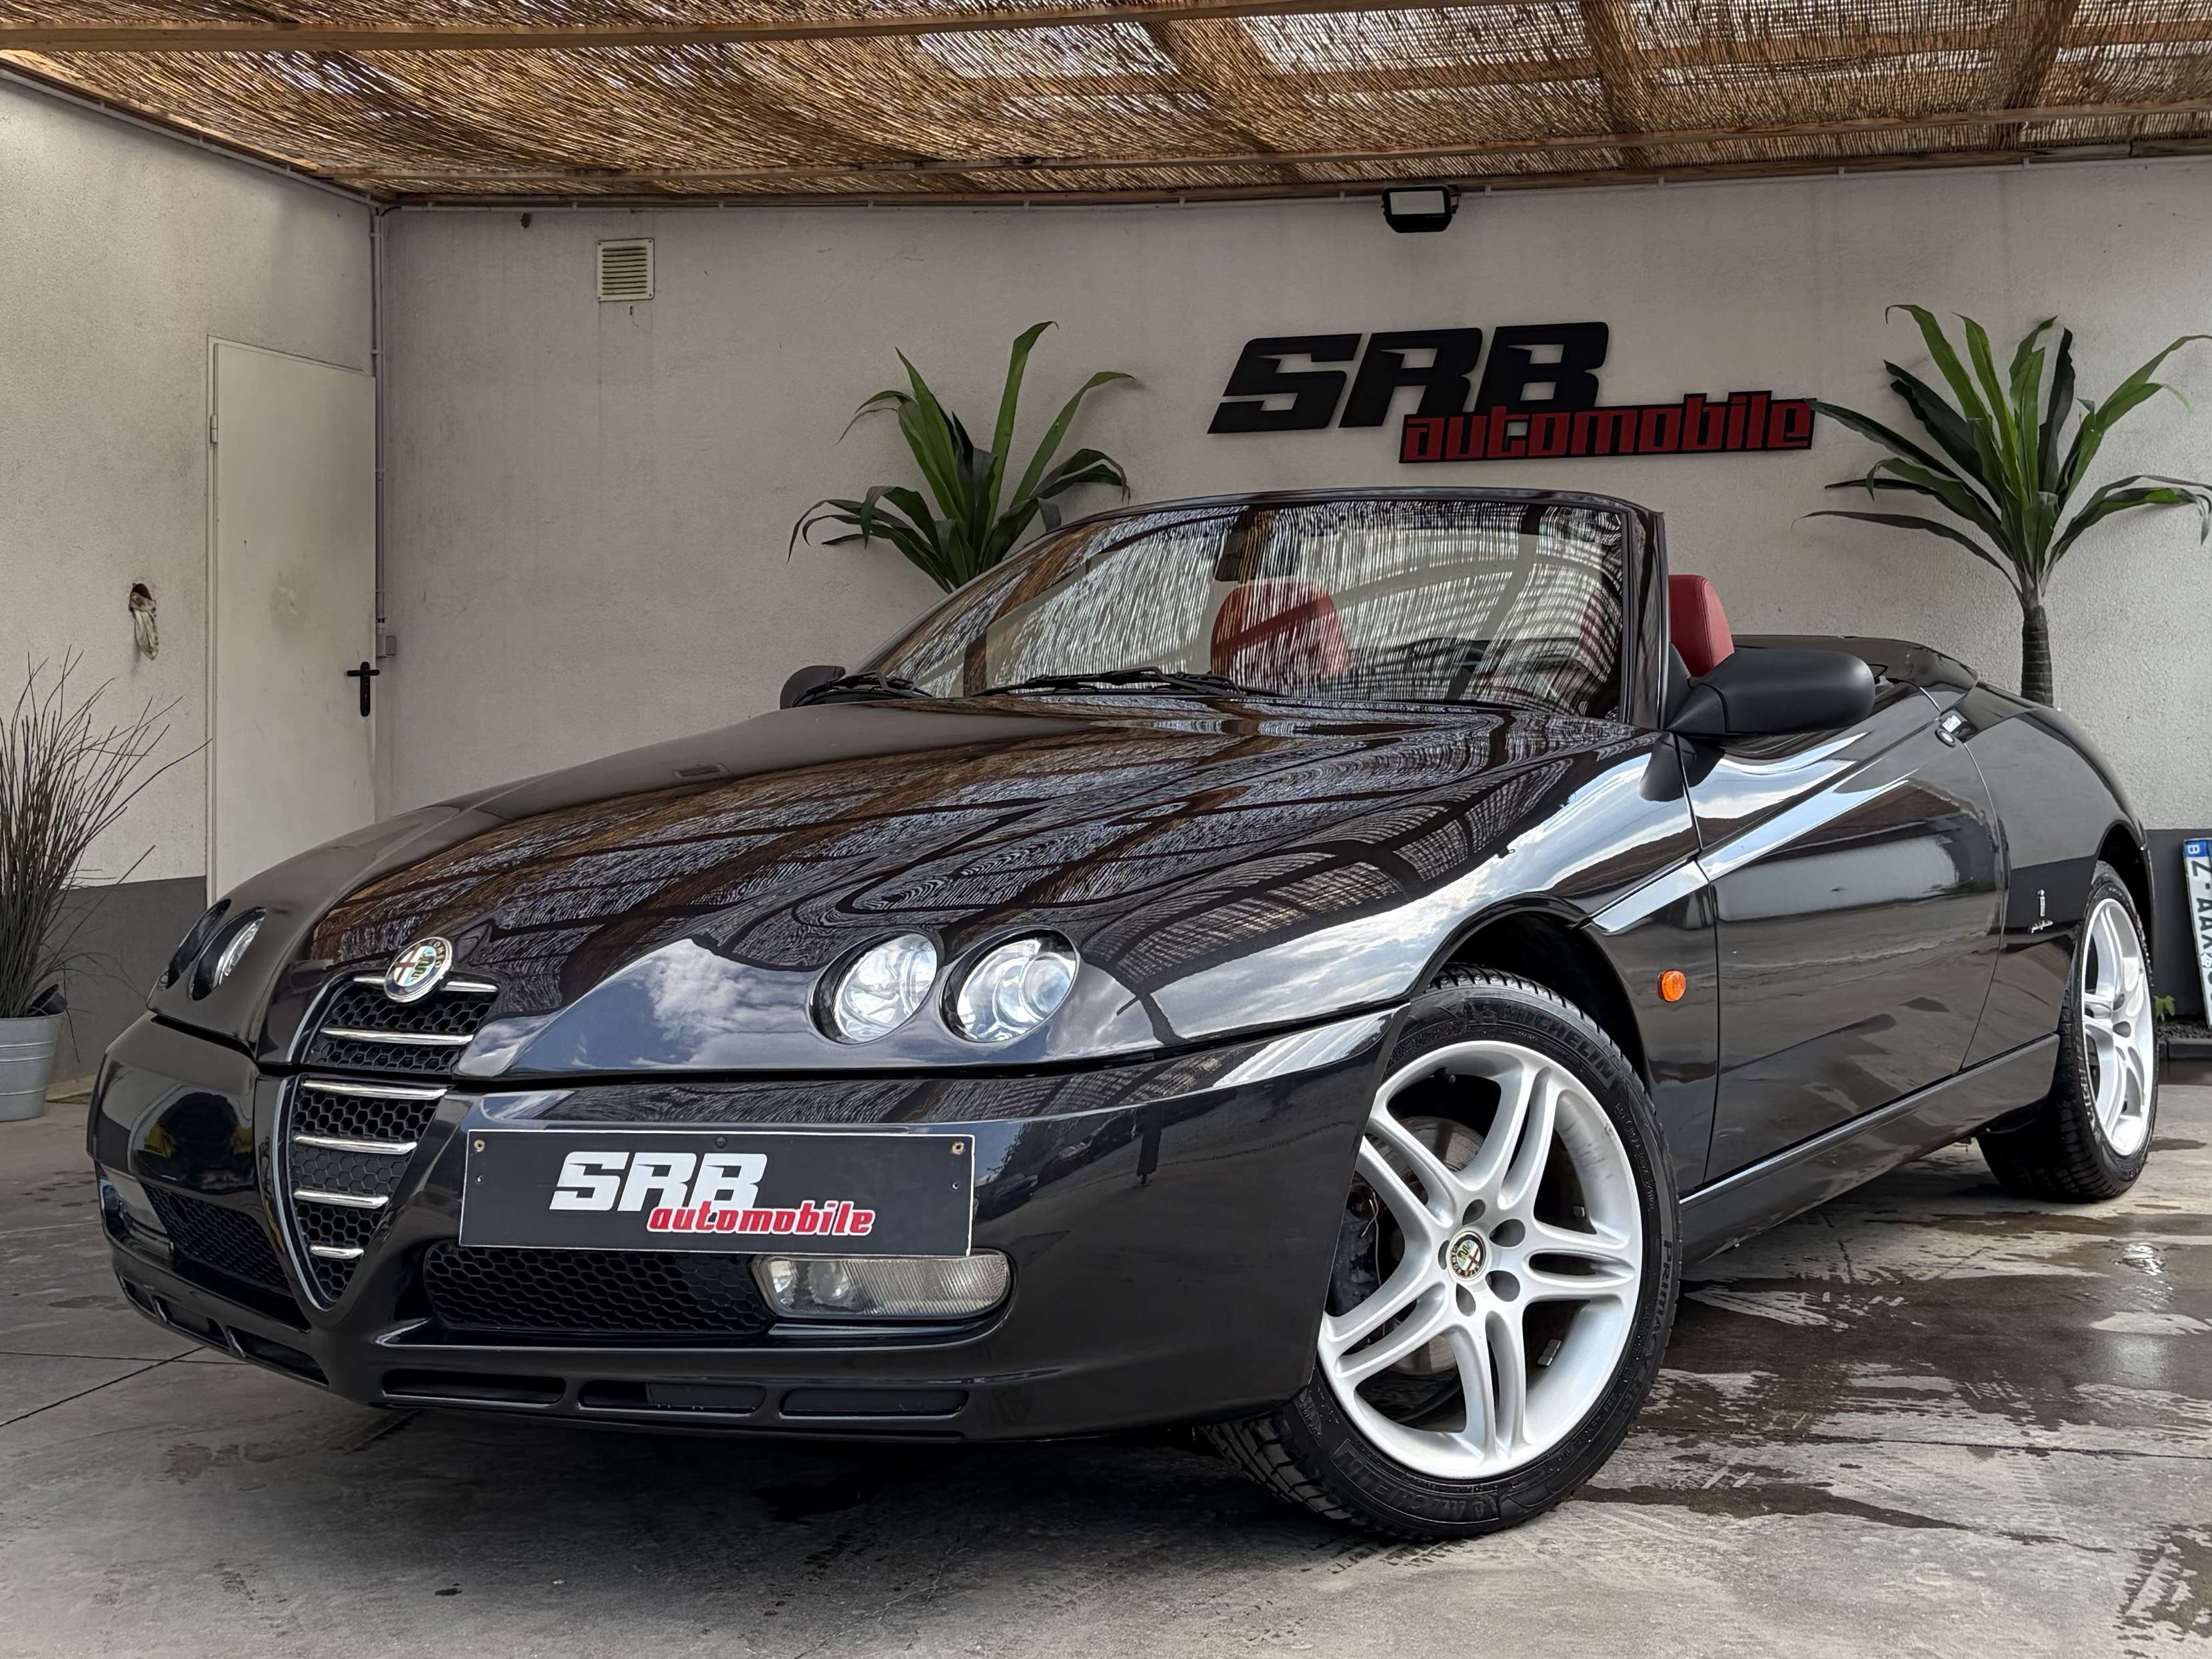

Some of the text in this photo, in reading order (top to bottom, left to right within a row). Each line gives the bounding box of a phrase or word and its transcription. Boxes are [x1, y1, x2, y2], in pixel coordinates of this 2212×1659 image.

[1207, 322, 1610, 435] SRB
[1401, 391, 1817, 463] automobile
[549, 1150, 768, 1212] SRB
[646, 1199, 876, 1236] automobile
